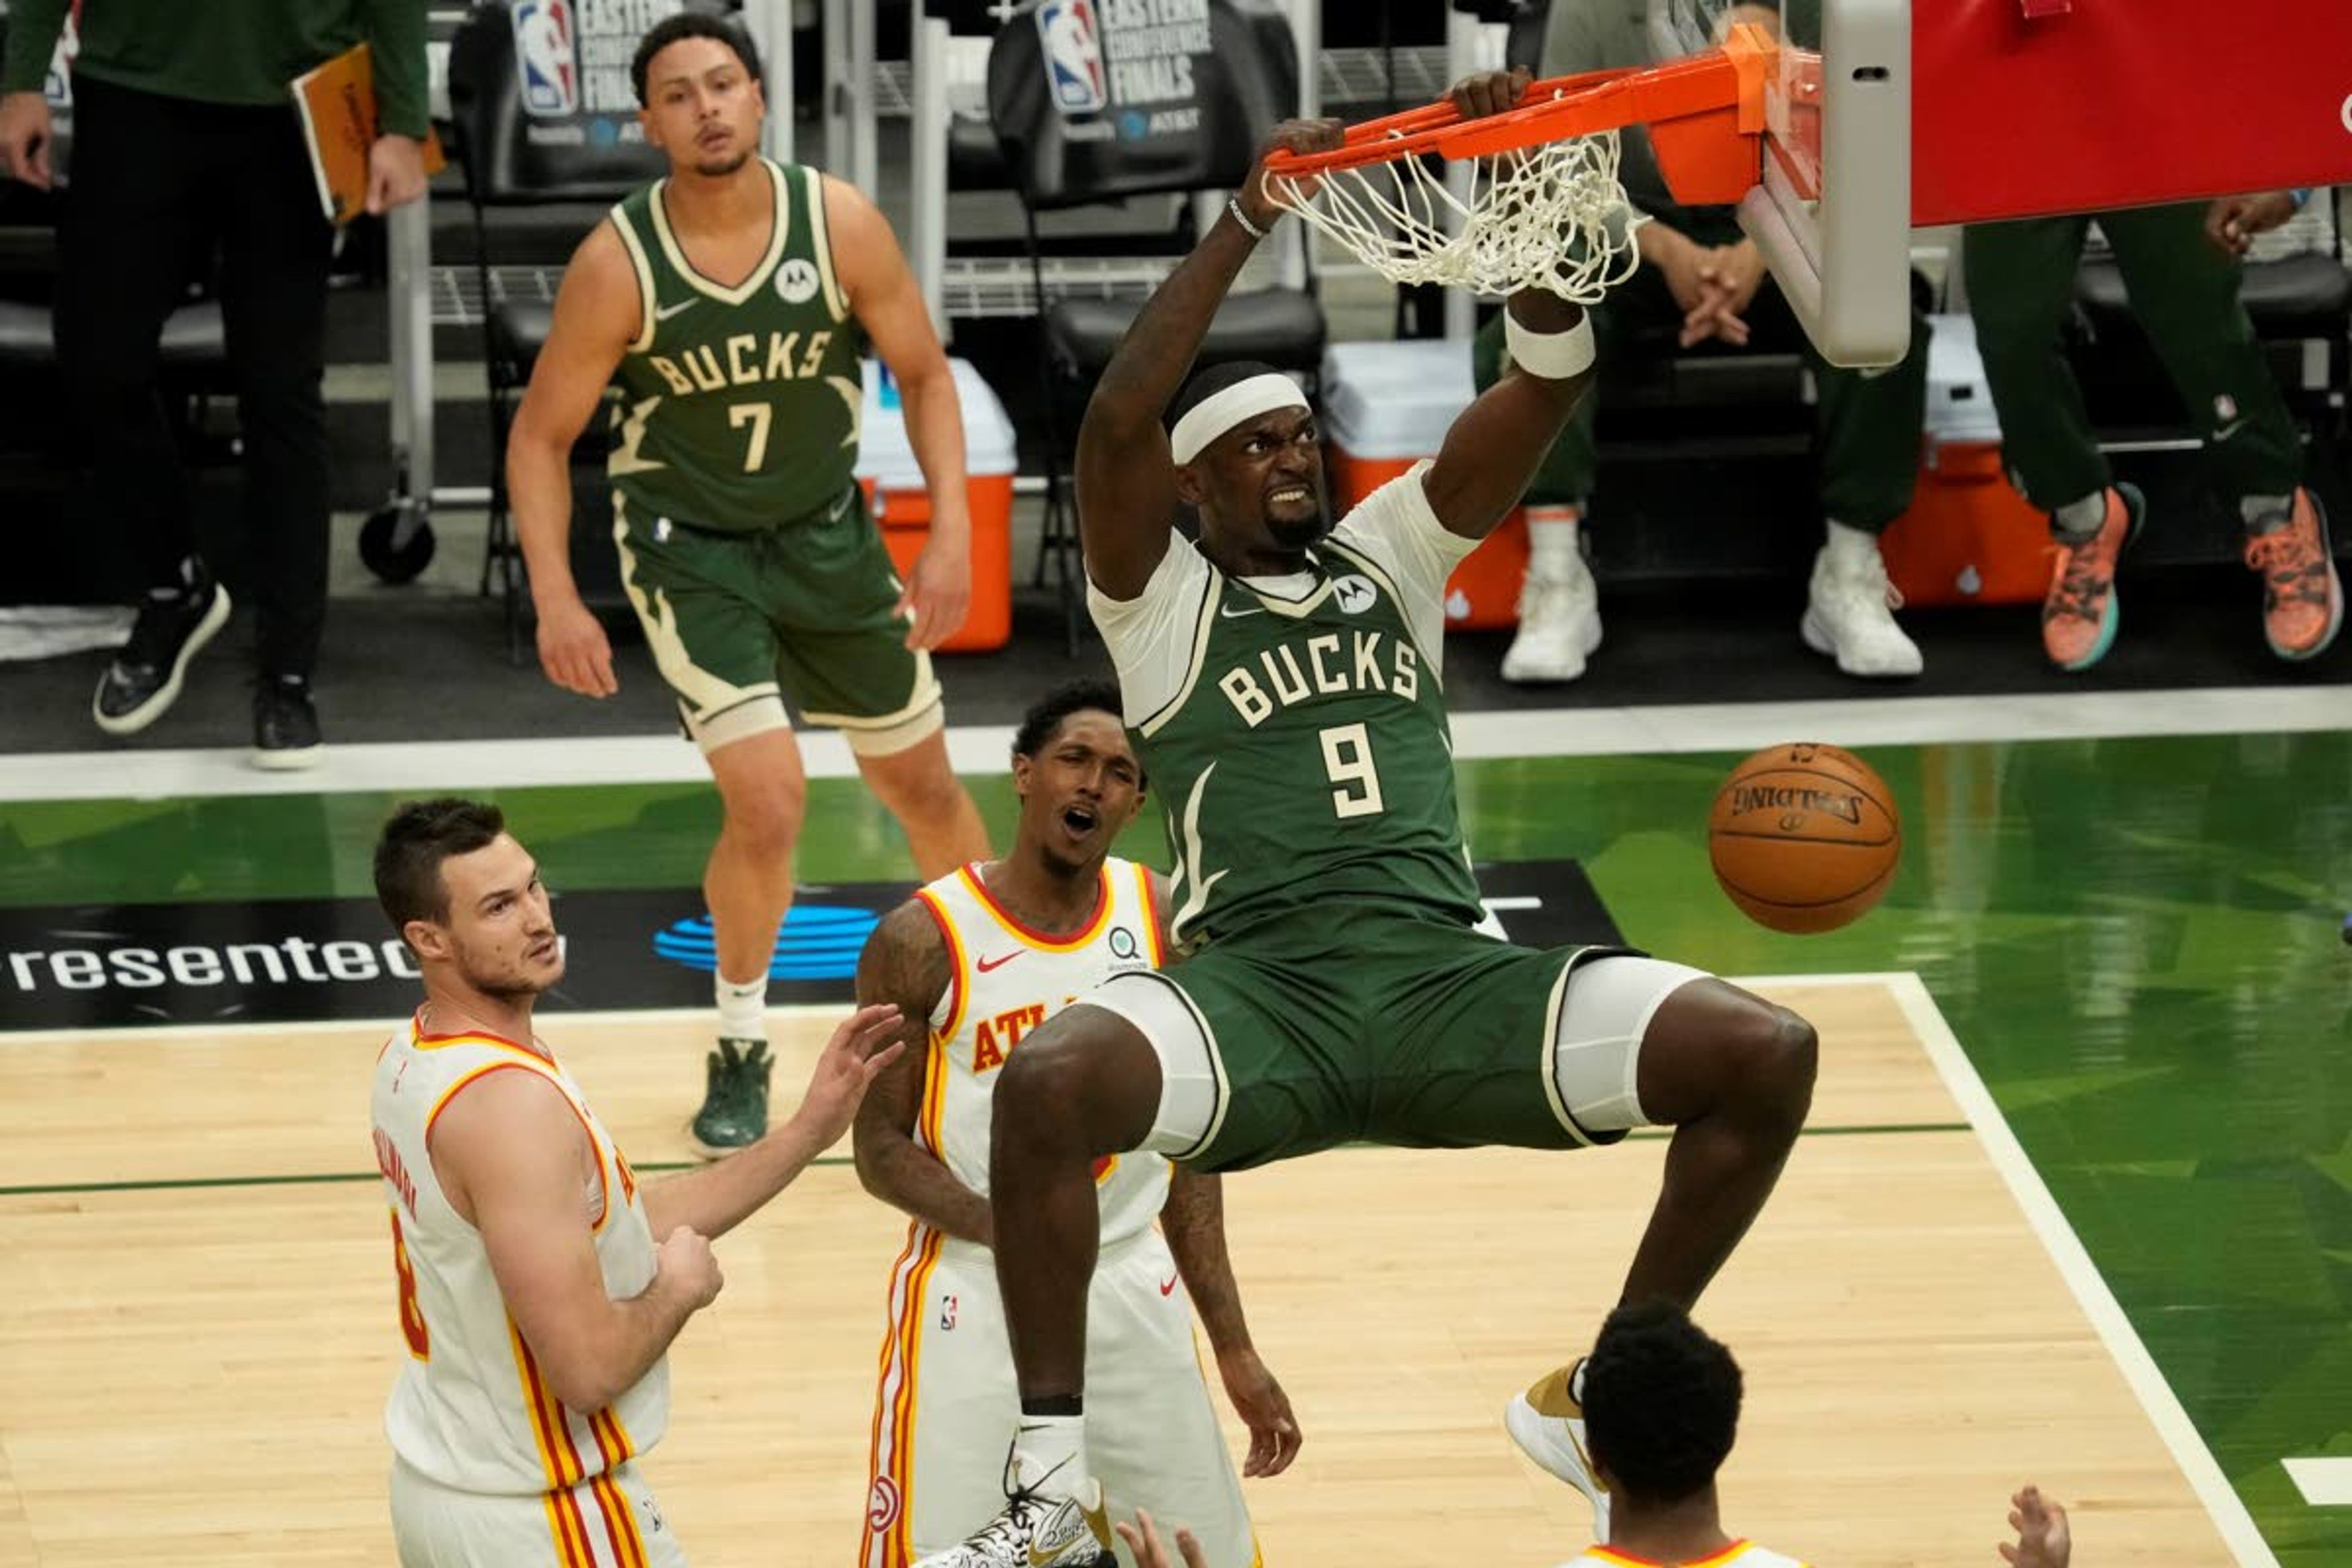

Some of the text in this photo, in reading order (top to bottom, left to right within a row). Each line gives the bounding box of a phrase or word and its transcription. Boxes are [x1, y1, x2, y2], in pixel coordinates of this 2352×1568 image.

[650, 331, 832, 395] BUCKS
[728, 402, 772, 472] 7
[1218, 630, 1418, 728] BUCKS
[1319, 722, 1385, 819] 9
[1732, 786, 1863, 825] SALDING
[0, 937, 423, 990] resente
